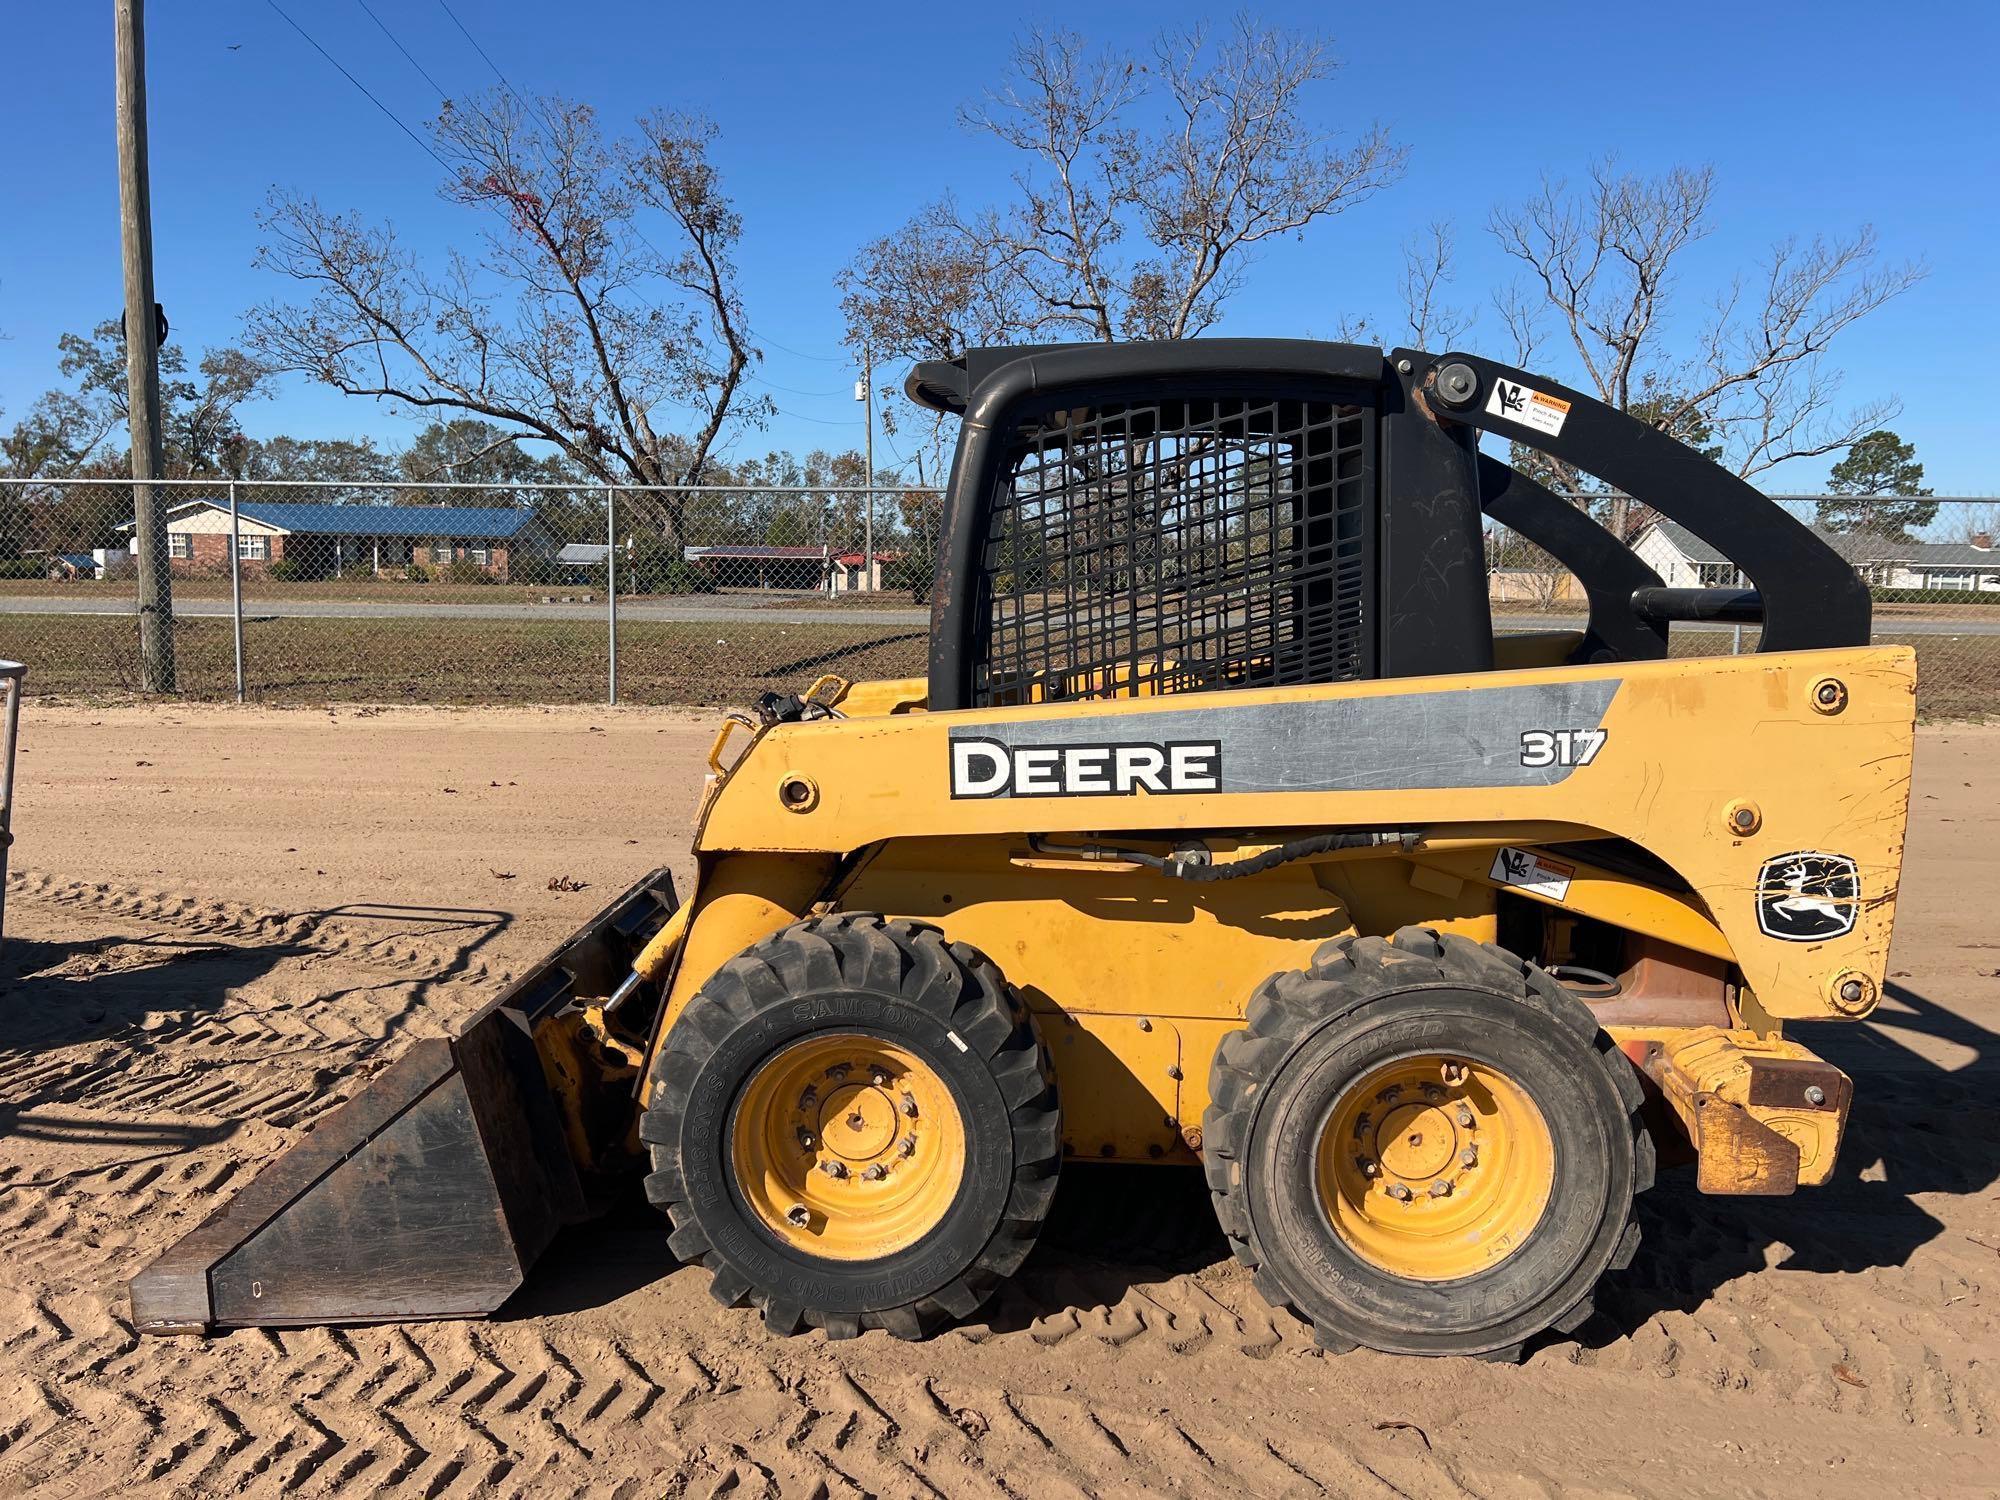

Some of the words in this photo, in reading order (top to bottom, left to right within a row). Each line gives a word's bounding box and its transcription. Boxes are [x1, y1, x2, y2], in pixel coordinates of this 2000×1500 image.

[1540, 397, 1567, 410] WARNING
[1522, 732, 1606, 766] 317
[952, 741, 1217, 796] DEERE
[792, 997, 920, 1033] SAMSON
[787, 1275, 846, 1303] SKID
[854, 1246, 960, 1303] PREMIUM
